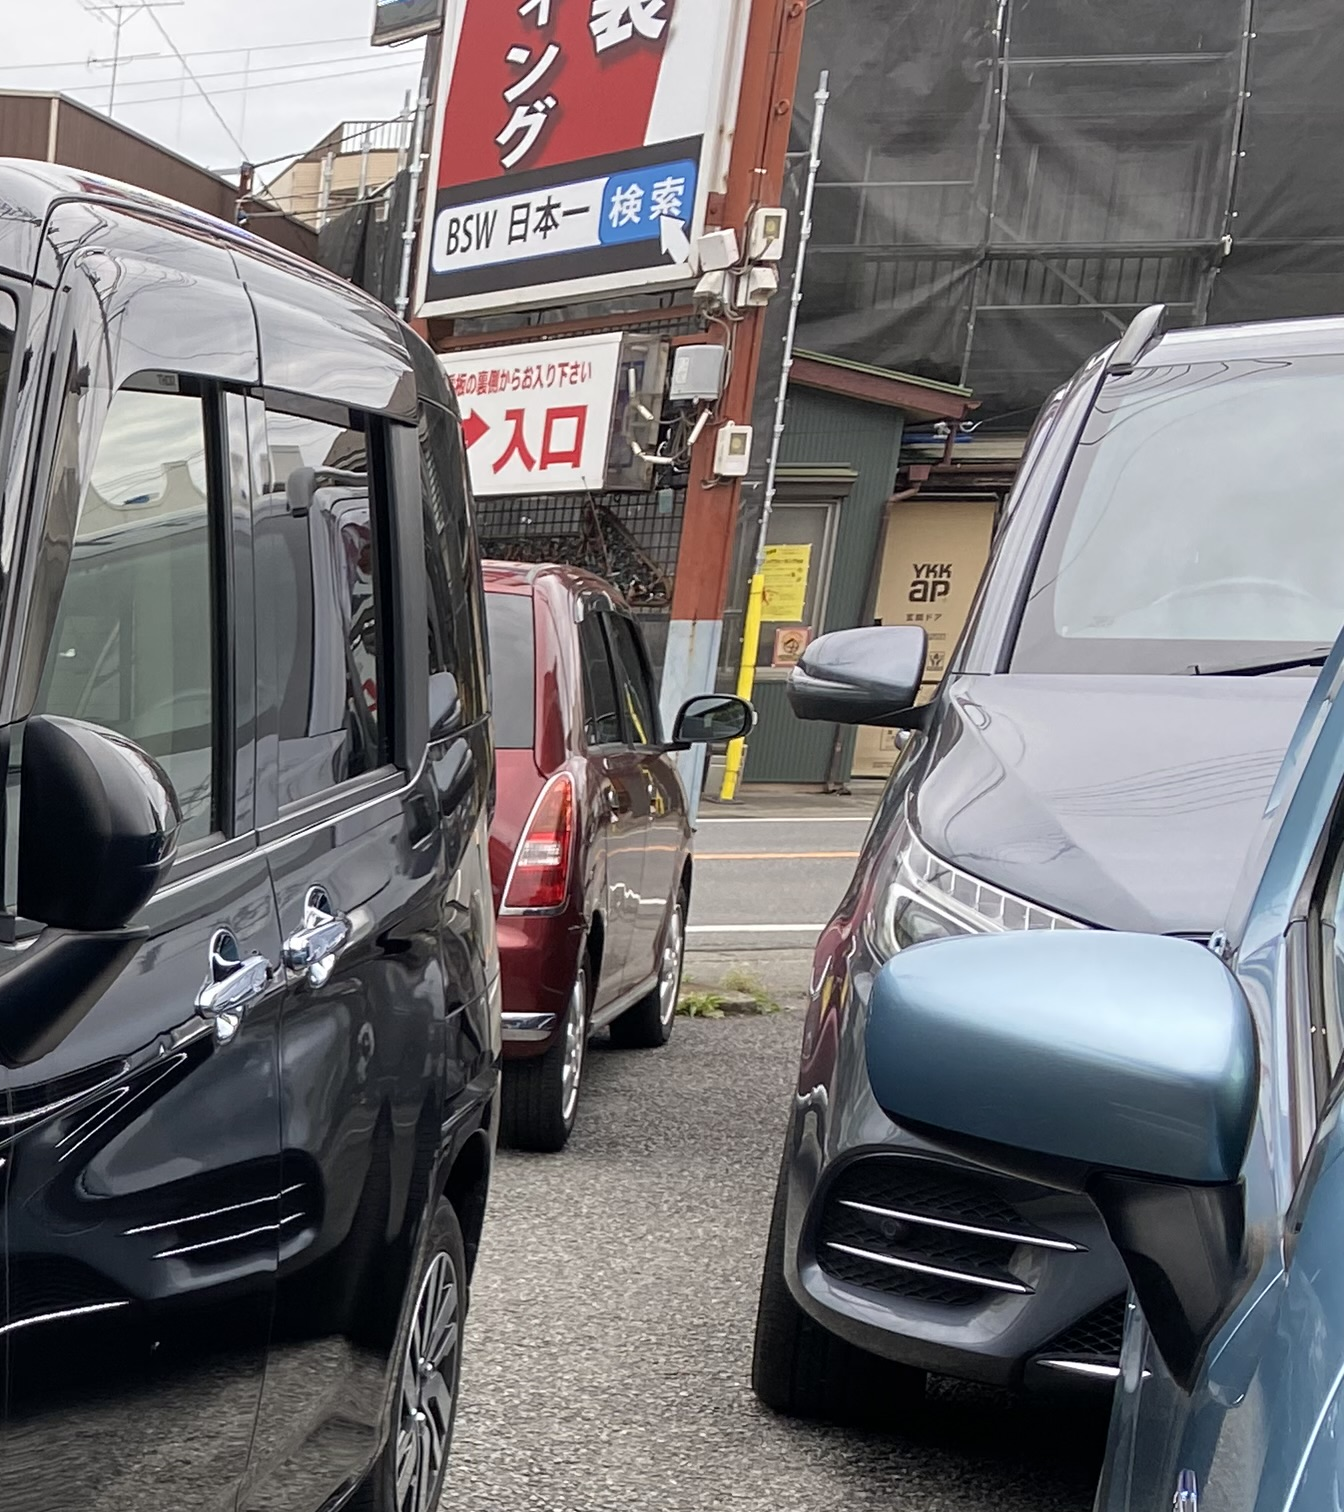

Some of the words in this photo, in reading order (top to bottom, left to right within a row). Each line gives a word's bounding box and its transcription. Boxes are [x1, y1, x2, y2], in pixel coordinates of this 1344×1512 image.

[446, 209, 498, 256] BSW
[508, 195, 591, 247] 日本一
[608, 176, 686, 228] 検索
[492, 404, 588, 475] 入口
[913, 563, 952, 579] YKK
